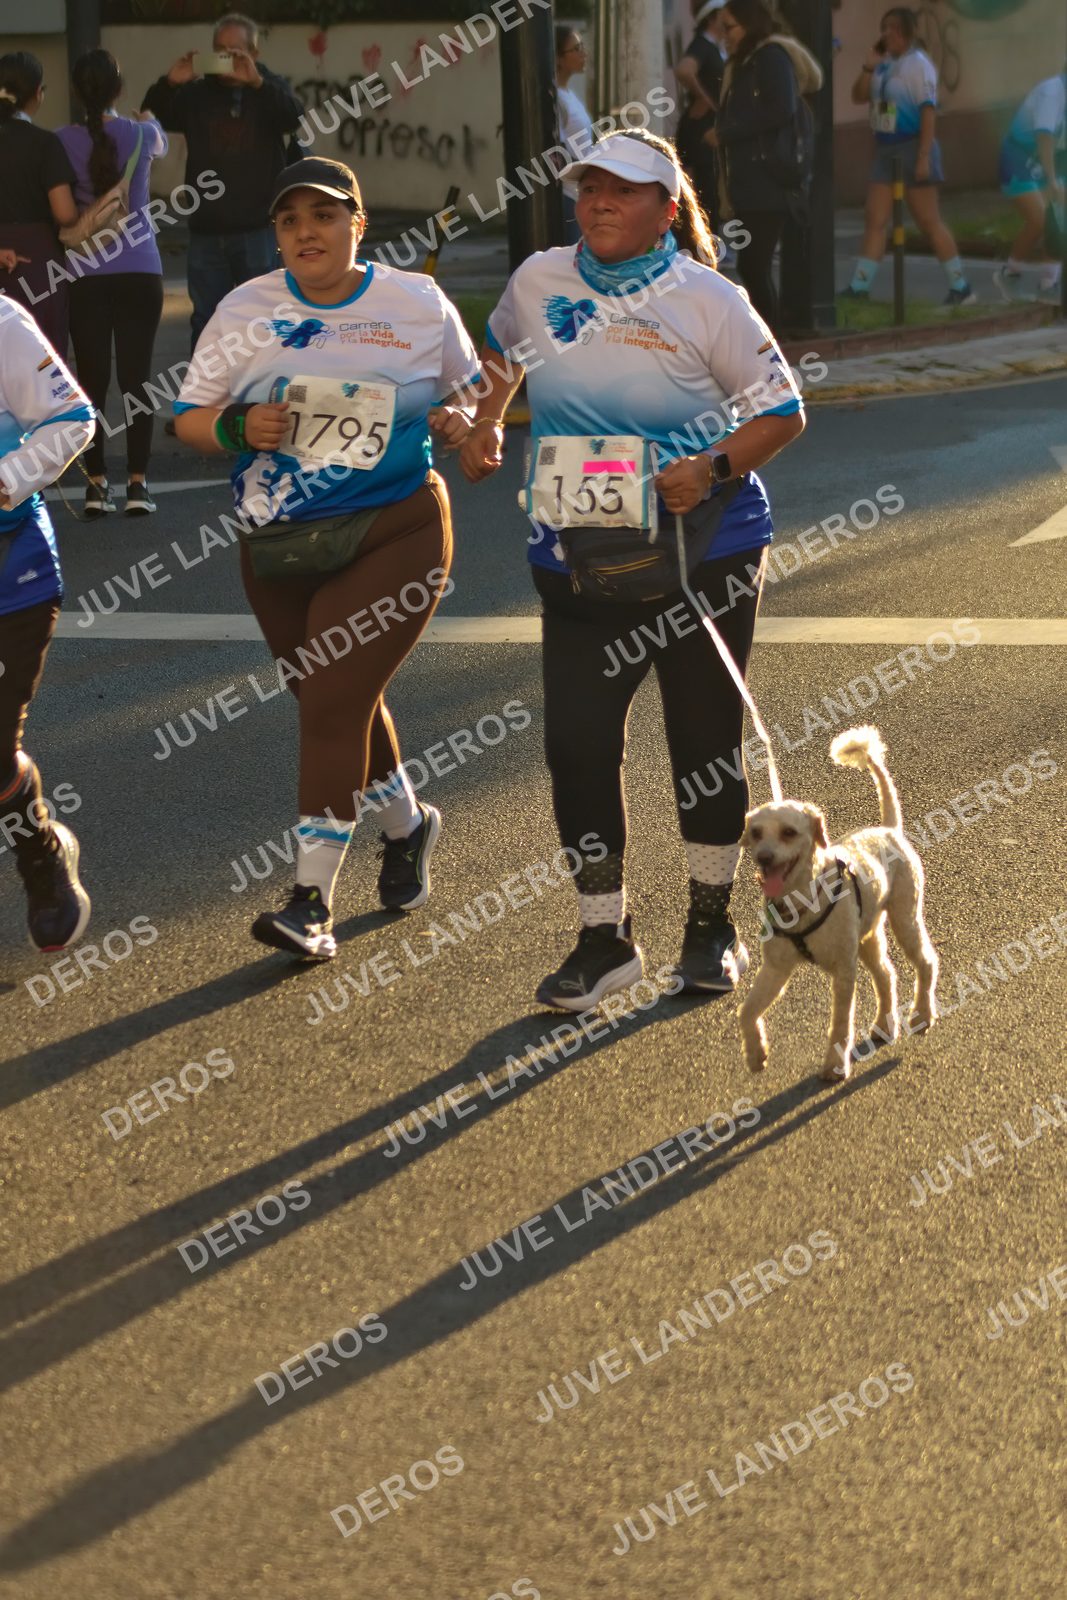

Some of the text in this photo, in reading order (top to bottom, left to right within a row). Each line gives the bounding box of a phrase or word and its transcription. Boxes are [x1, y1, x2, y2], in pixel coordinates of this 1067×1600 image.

[339, 321, 392, 331] Carrera
[610, 313, 660, 329] Carrera
[370, 330, 394, 338] Vida
[637, 328, 660, 339] Vida
[360, 337, 411, 350] Integridad
[624, 336, 677, 352] Integridad
[290, 411, 388, 458] 1795
[552, 475, 623, 515] 155
